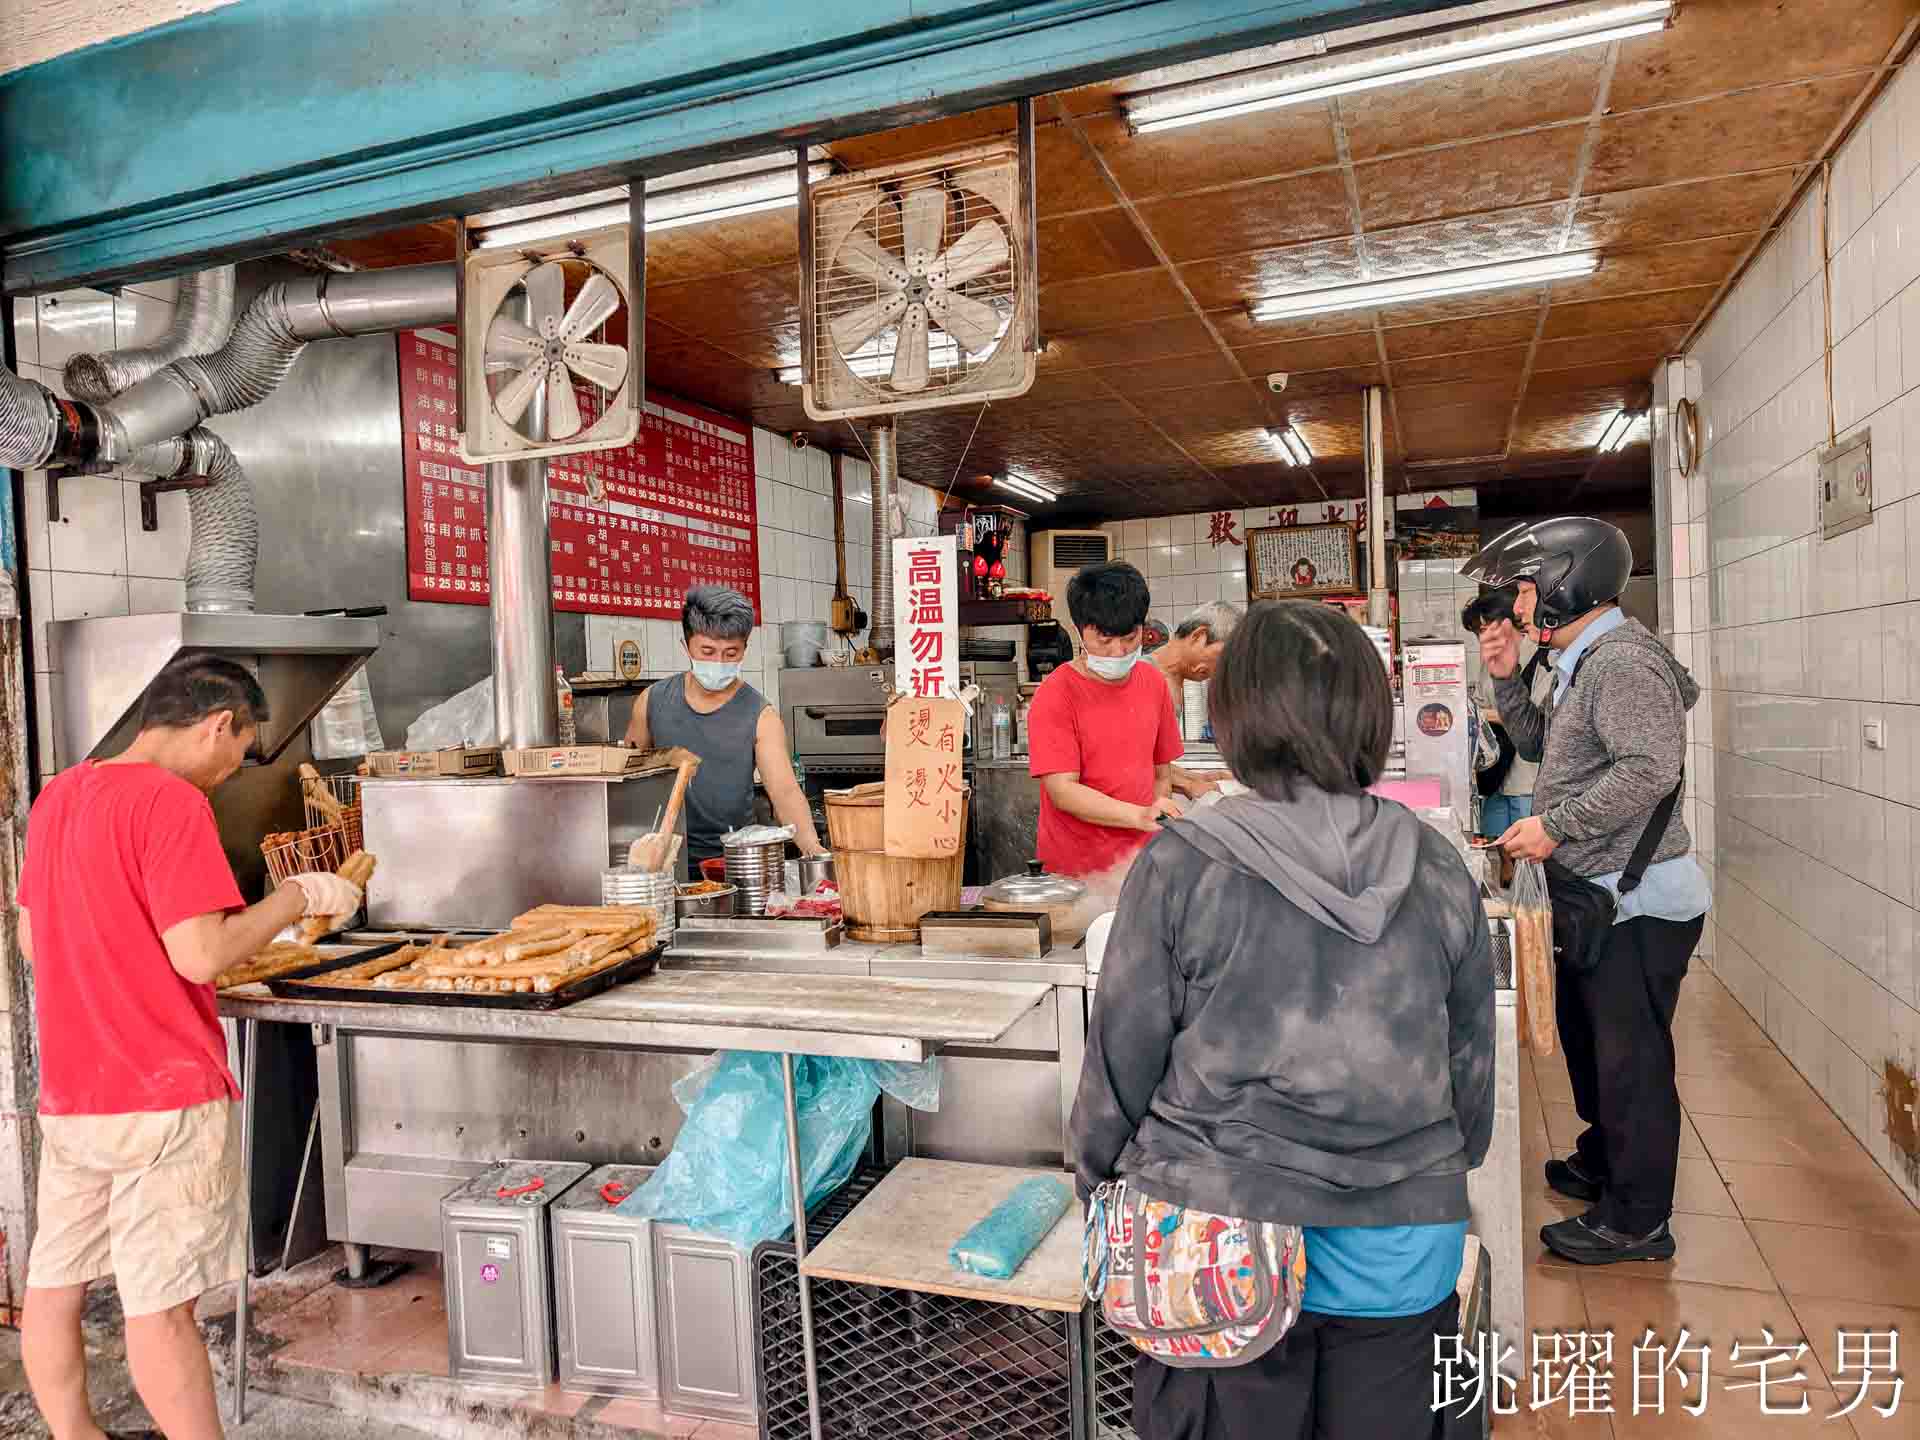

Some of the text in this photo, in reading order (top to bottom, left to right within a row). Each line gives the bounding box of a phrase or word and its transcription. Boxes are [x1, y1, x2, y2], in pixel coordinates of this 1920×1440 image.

[907, 548, 945, 698] 高溫勿近
[905, 708, 931, 809] 燙燙
[934, 723, 962, 850] 有火小心
